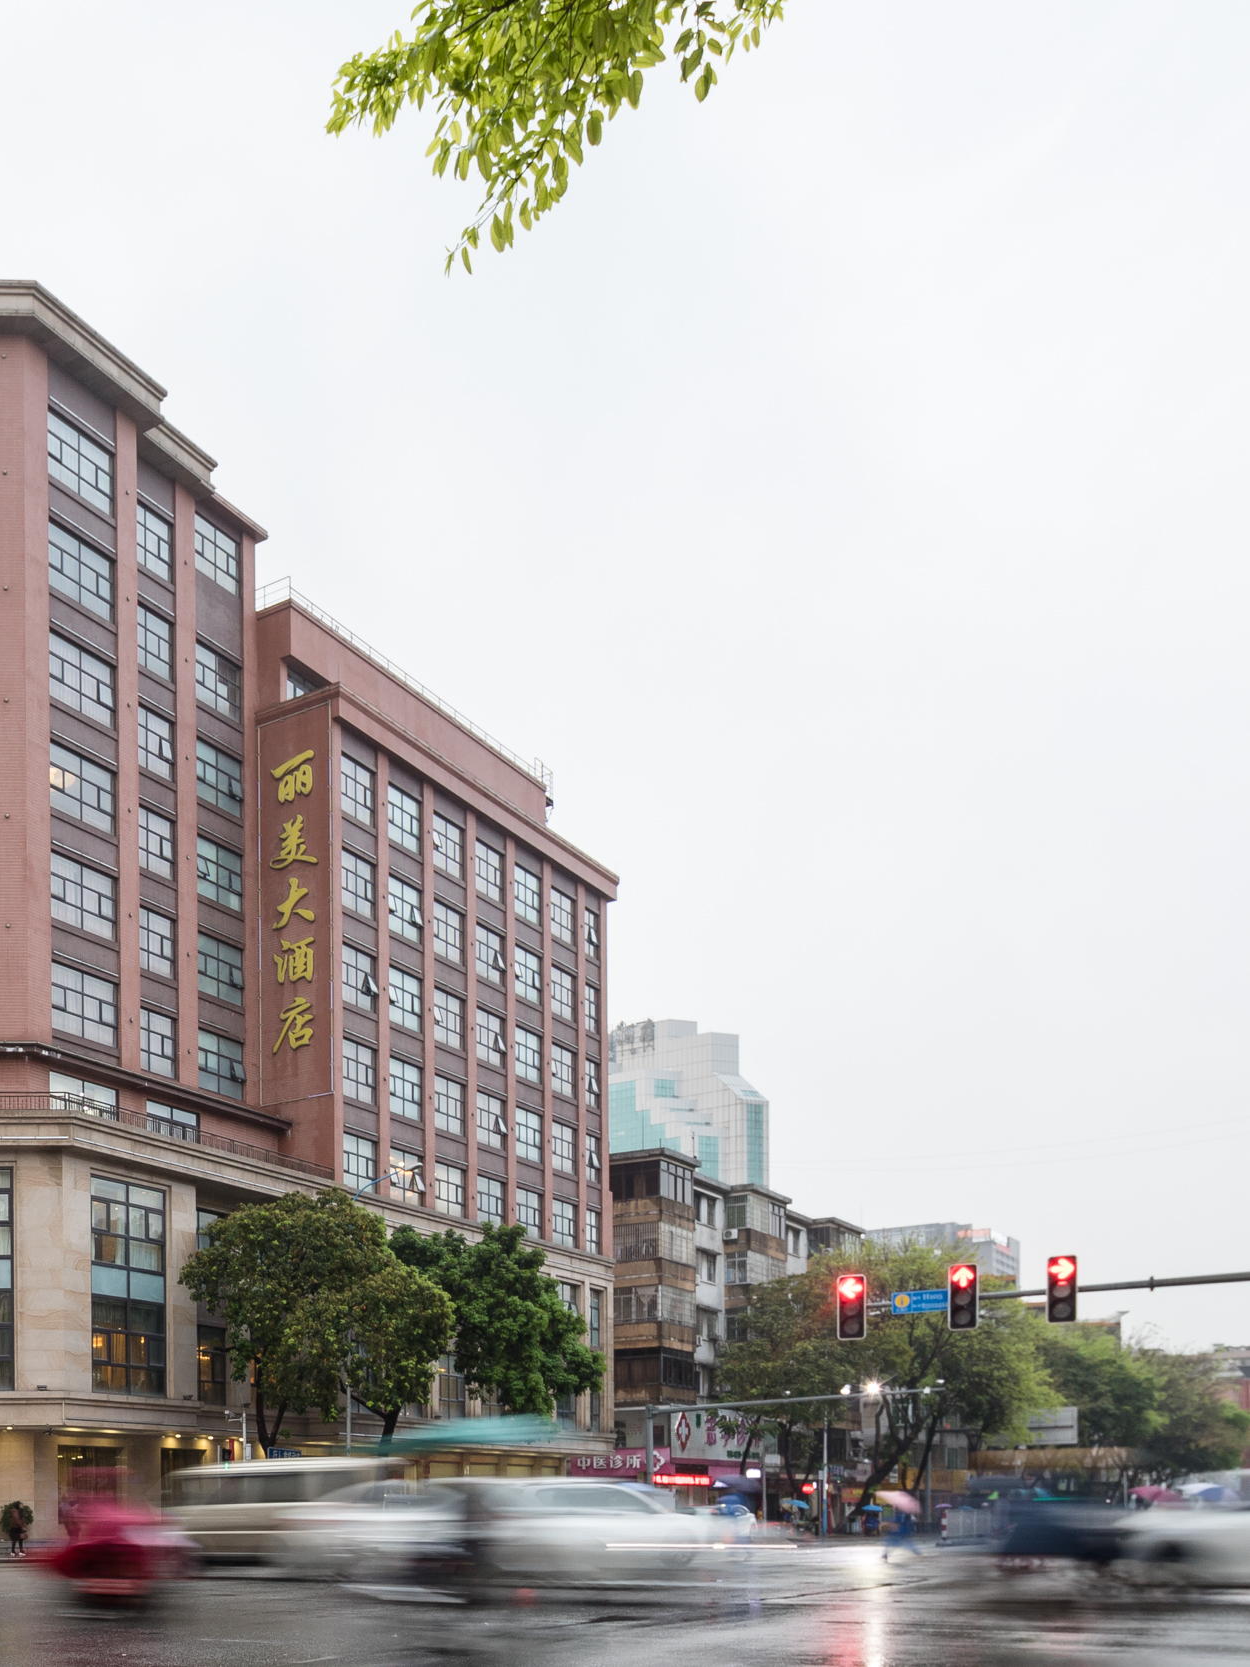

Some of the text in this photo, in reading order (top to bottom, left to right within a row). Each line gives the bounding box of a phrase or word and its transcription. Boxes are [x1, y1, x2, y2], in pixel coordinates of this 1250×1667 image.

[269, 749, 318, 1053] 丽美大酒店
[577, 1454, 642, 1470] 中医诊所
